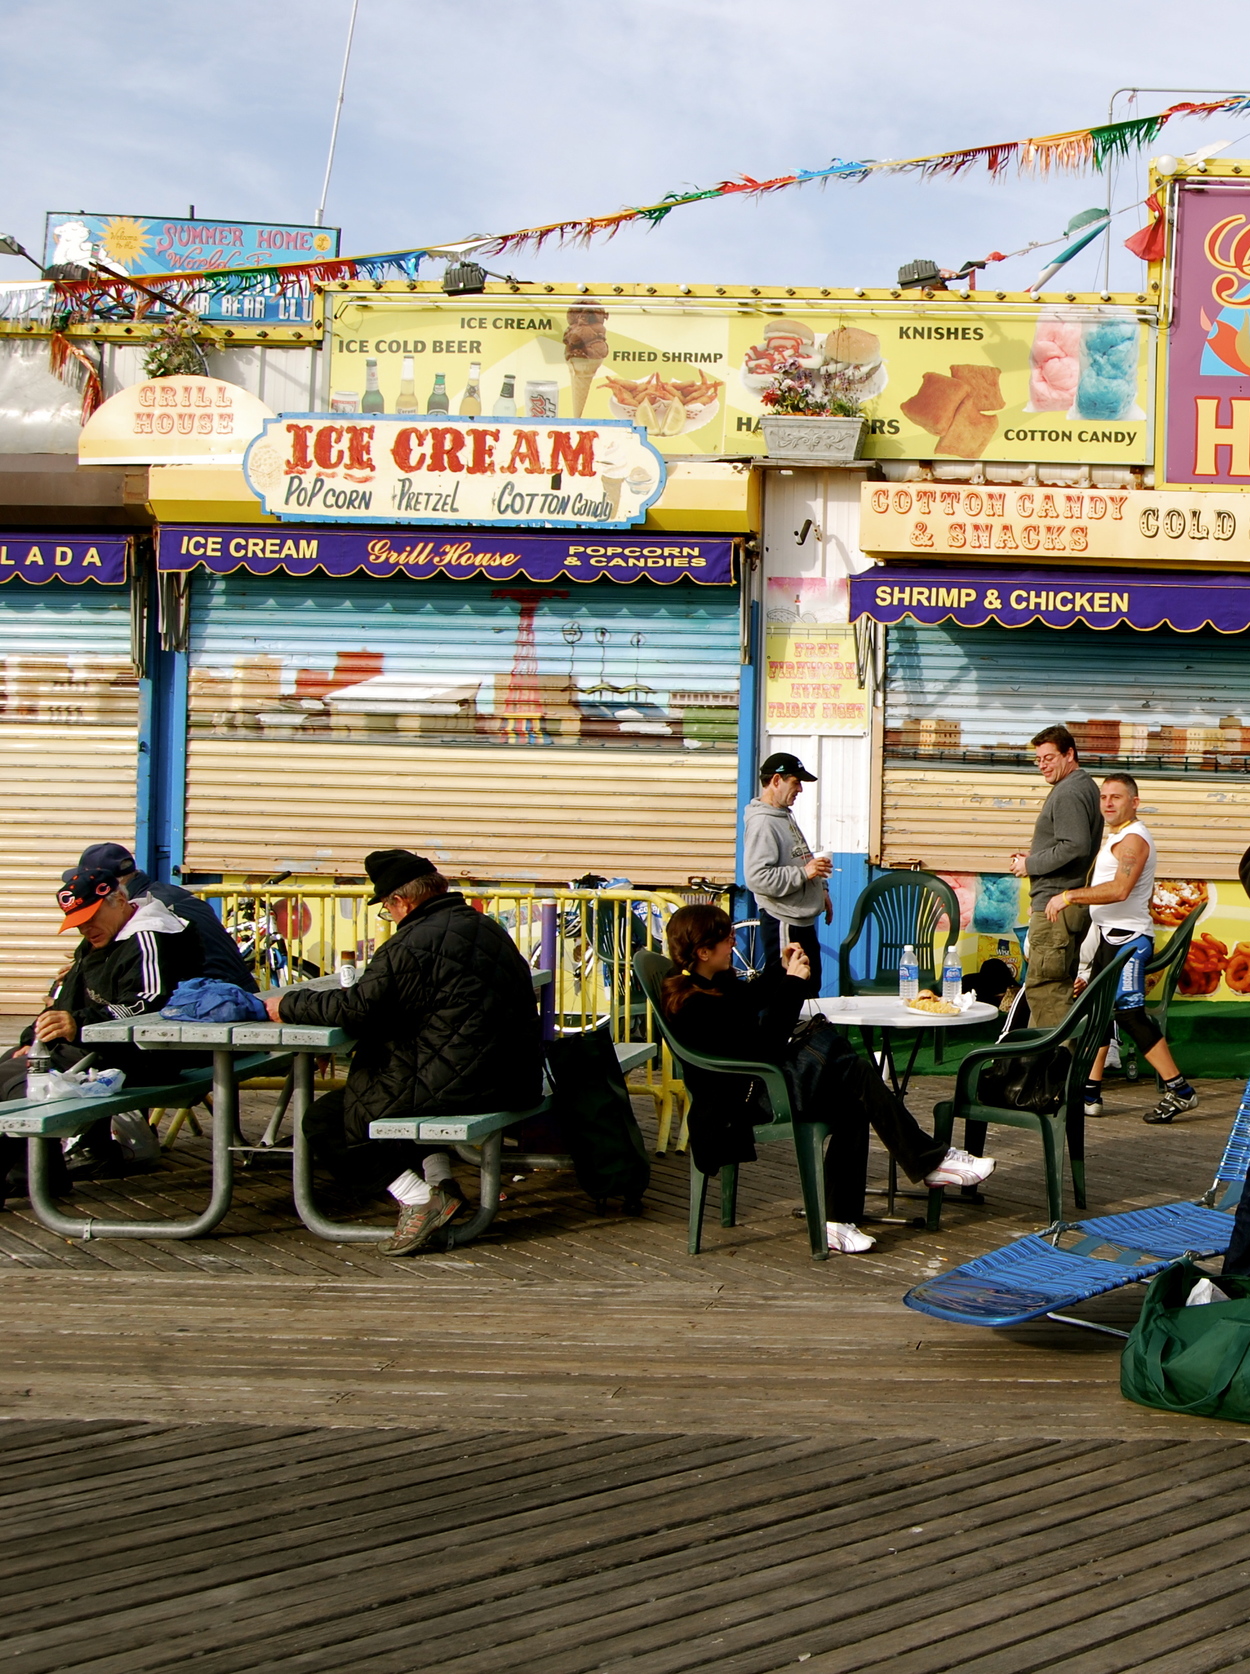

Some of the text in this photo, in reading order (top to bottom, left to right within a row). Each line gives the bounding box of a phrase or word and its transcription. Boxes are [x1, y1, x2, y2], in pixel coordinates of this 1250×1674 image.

[155, 223, 314, 254] SUMMER HOME
[221, 294, 265, 318] BEAR
[460, 317, 553, 331] ICE CREAM
[899, 326, 984, 341] KNISHES
[338, 340, 482, 354] ICE COLD BEER
[613, 351, 723, 364] FRIED SHRIMP
[138, 385, 233, 408] GRILL
[133, 412, 234, 434] HOUSE
[1003, 429, 1138, 447] COTTON CANDY
[284, 424, 599, 477] ICE CREAM
[397, 479, 460, 512] PRETZEL
[497, 481, 569, 516] COTTON
[571, 493, 614, 522] Candy
[871, 488, 1128, 521] COTTON CANDY
[1139, 507, 1236, 540] COLD
[181, 535, 318, 559] ICE CREAM
[909, 521, 1089, 552] & SNACKS
[367, 539, 522, 567] Grill House
[564, 556, 708, 568] & CANDIES
[568, 545, 700, 557] POPCORN
[875, 585, 1129, 613] SHRIMP & CHICKEN
[794, 642, 839, 659] FREE
[768, 661, 858, 680] FIREWORK
[790, 683, 842, 699] EVERY
[768, 702, 866, 719] FRIDAY NIGHT
